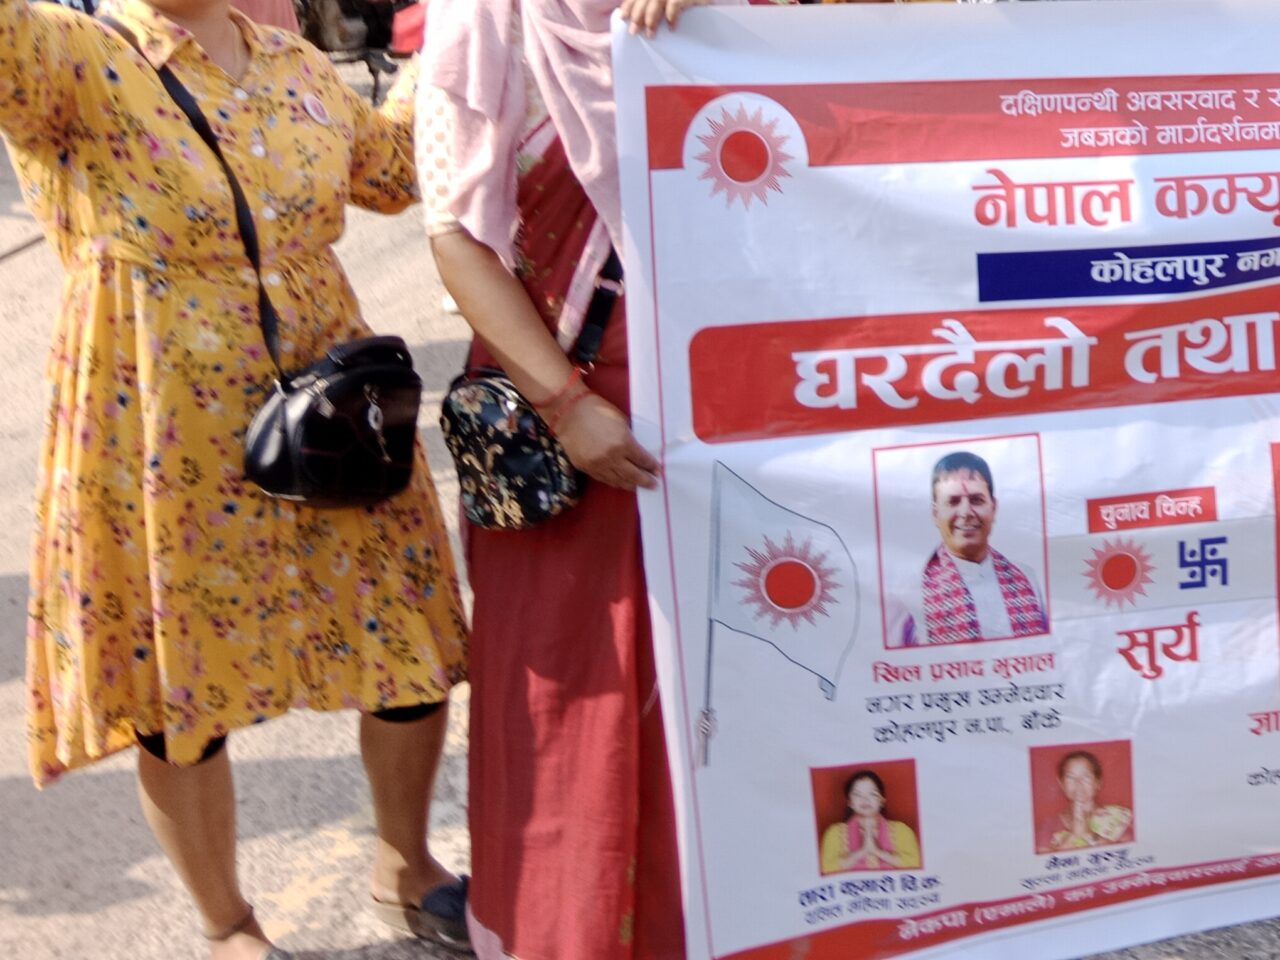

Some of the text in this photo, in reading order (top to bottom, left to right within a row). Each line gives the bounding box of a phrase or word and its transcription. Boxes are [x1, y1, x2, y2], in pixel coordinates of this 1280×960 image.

[1000, 88, 1119, 116] दक्षिणपन्थी
[1127, 89, 1236, 112] अवसरवाद
[1244, 89, 1260, 108] र
[1060, 120, 1149, 149] जबजको
[971, 168, 1135, 229] नेपाल
[1090, 252, 1229, 286] कोहलपुर
[791, 317, 1098, 411] घरदैलो
[1124, 311, 1280, 384] तथा
[1099, 500, 1151, 529] चुनाव
[1117, 610, 1202, 680] सुर्य
[929, 659, 985, 682] प्रसाद
